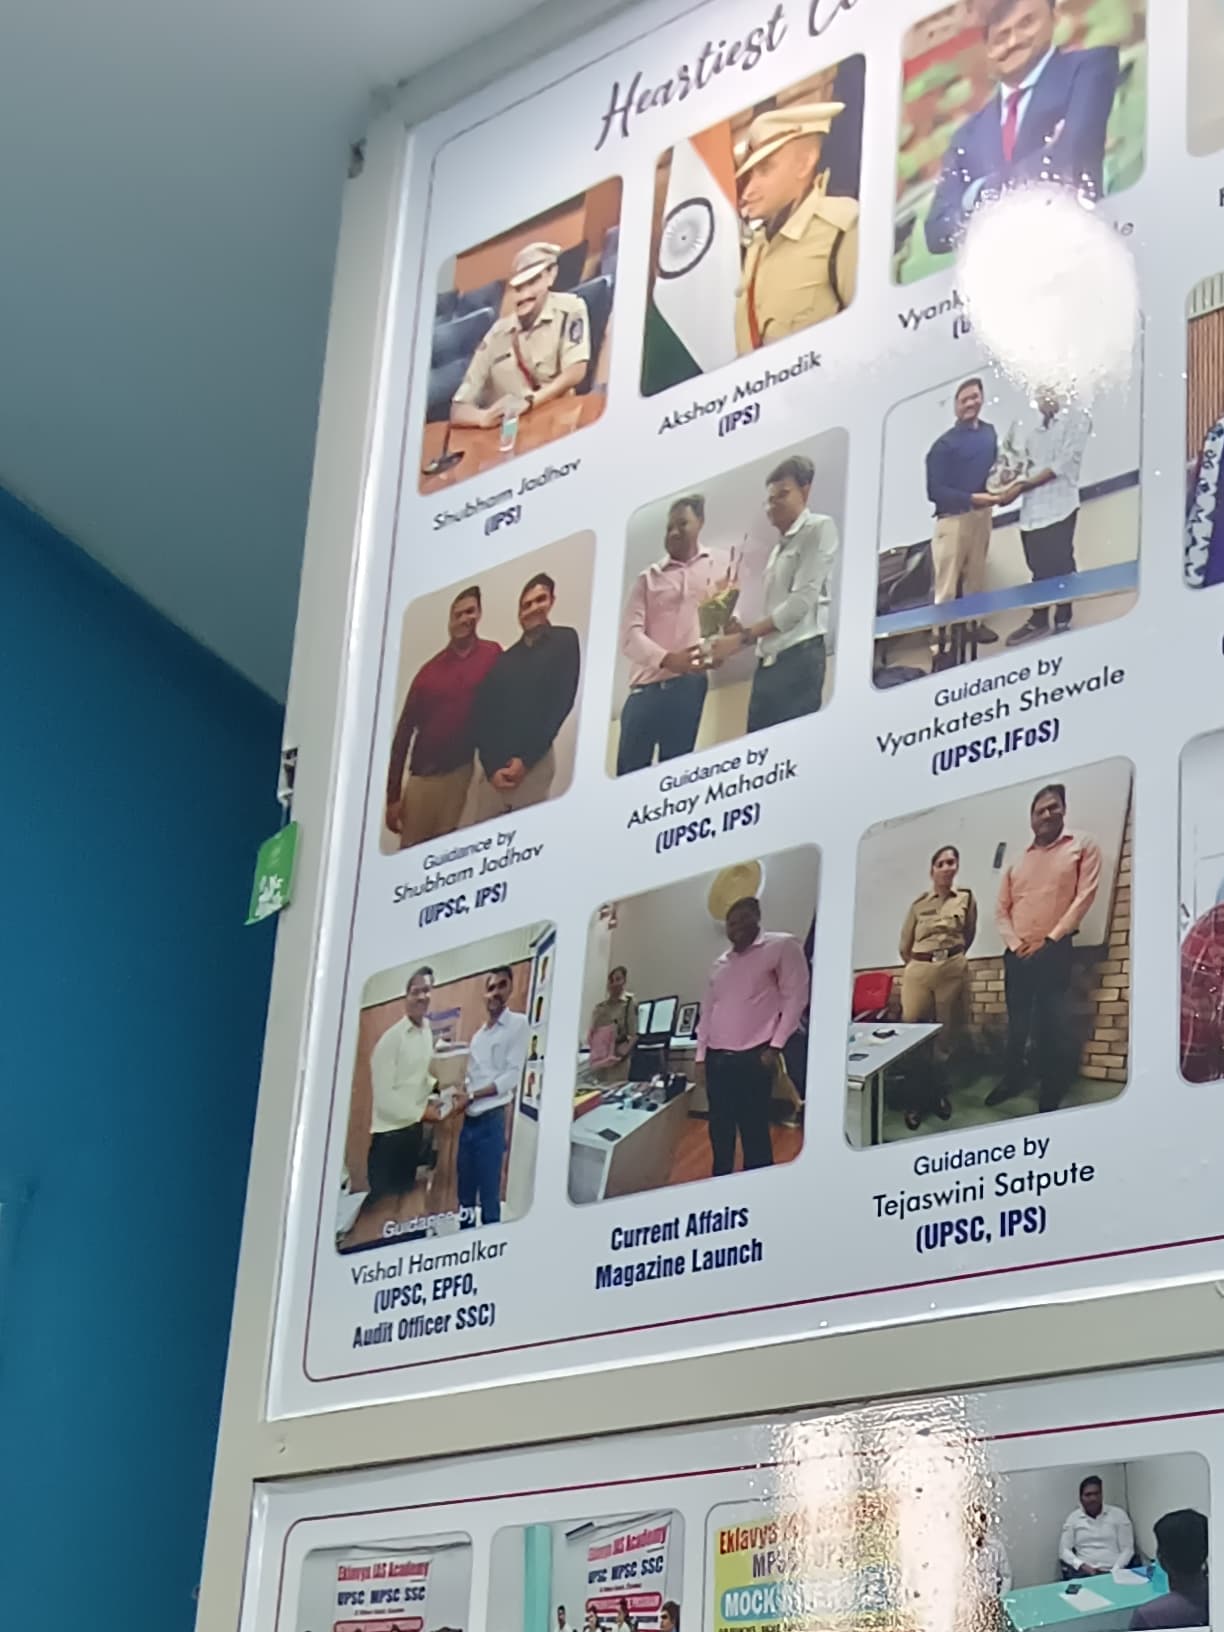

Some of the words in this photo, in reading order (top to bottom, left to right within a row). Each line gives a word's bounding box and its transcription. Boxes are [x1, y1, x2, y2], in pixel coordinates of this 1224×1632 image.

[594, 3, 788, 151] Heartiest
[658, 394, 727, 434] Akshay
[732, 351, 822, 402] Mahadik
[717, 403, 760, 437] (IPS)
[432, 488, 514, 532] Shubham
[518, 458, 581, 495] Jadhav
[483, 504, 522, 536] (IPS)
[935, 666, 1031, 707] Guidance
[1037, 656, 1063, 676] by
[876, 698, 1010, 757] Vyankatesh
[1019, 665, 1125, 712] Shewale
[659, 757, 742, 793] Guidance
[746, 745, 769, 774] by
[931, 718, 1060, 776] (UPSC,IFoS)
[627, 788, 699, 829] Akshay
[705, 760, 798, 803] Mahadik
[423, 840, 493, 871] Guidance
[497, 829, 517, 854] by
[655, 819, 717, 854] (UPSC,
[722, 802, 761, 834] IPS)
[392, 866, 475, 905] Shubham
[479, 841, 544, 878] Jadhav
[418, 893, 471, 929] (UPSC,
[474, 882, 508, 914] IPS)
[913, 1141, 1016, 1177] Guidance
[1022, 1134, 1050, 1163] by
[872, 1179, 985, 1221] Tejaswini
[994, 1160, 1096, 1198] Satpute
[610, 1218, 681, 1252] Current
[685, 1206, 749, 1239] Affairs
[916, 1215, 992, 1254] (UPSC,
[999, 1204, 1047, 1240] IPS)
[351, 1255, 402, 1287] Vishal
[408, 1238, 508, 1276] Harmalkar
[595, 1253, 686, 1290] Magazine
[691, 1237, 763, 1272] Launch
[373, 1285, 427, 1314] (UPSC,
[432, 1272, 478, 1303] EPFO,
[352, 1321, 393, 1349] Audit
[398, 1312, 451, 1343] Officer
[456, 1302, 496, 1331] SSC)
[641, 1555, 664, 1576] SSC
[337, 1590, 365, 1606] UPSC
[370, 1588, 400, 1604] MPSC
[405, 1586, 426, 1601] SSC
[724, 1586, 778, 1618] MOCK
